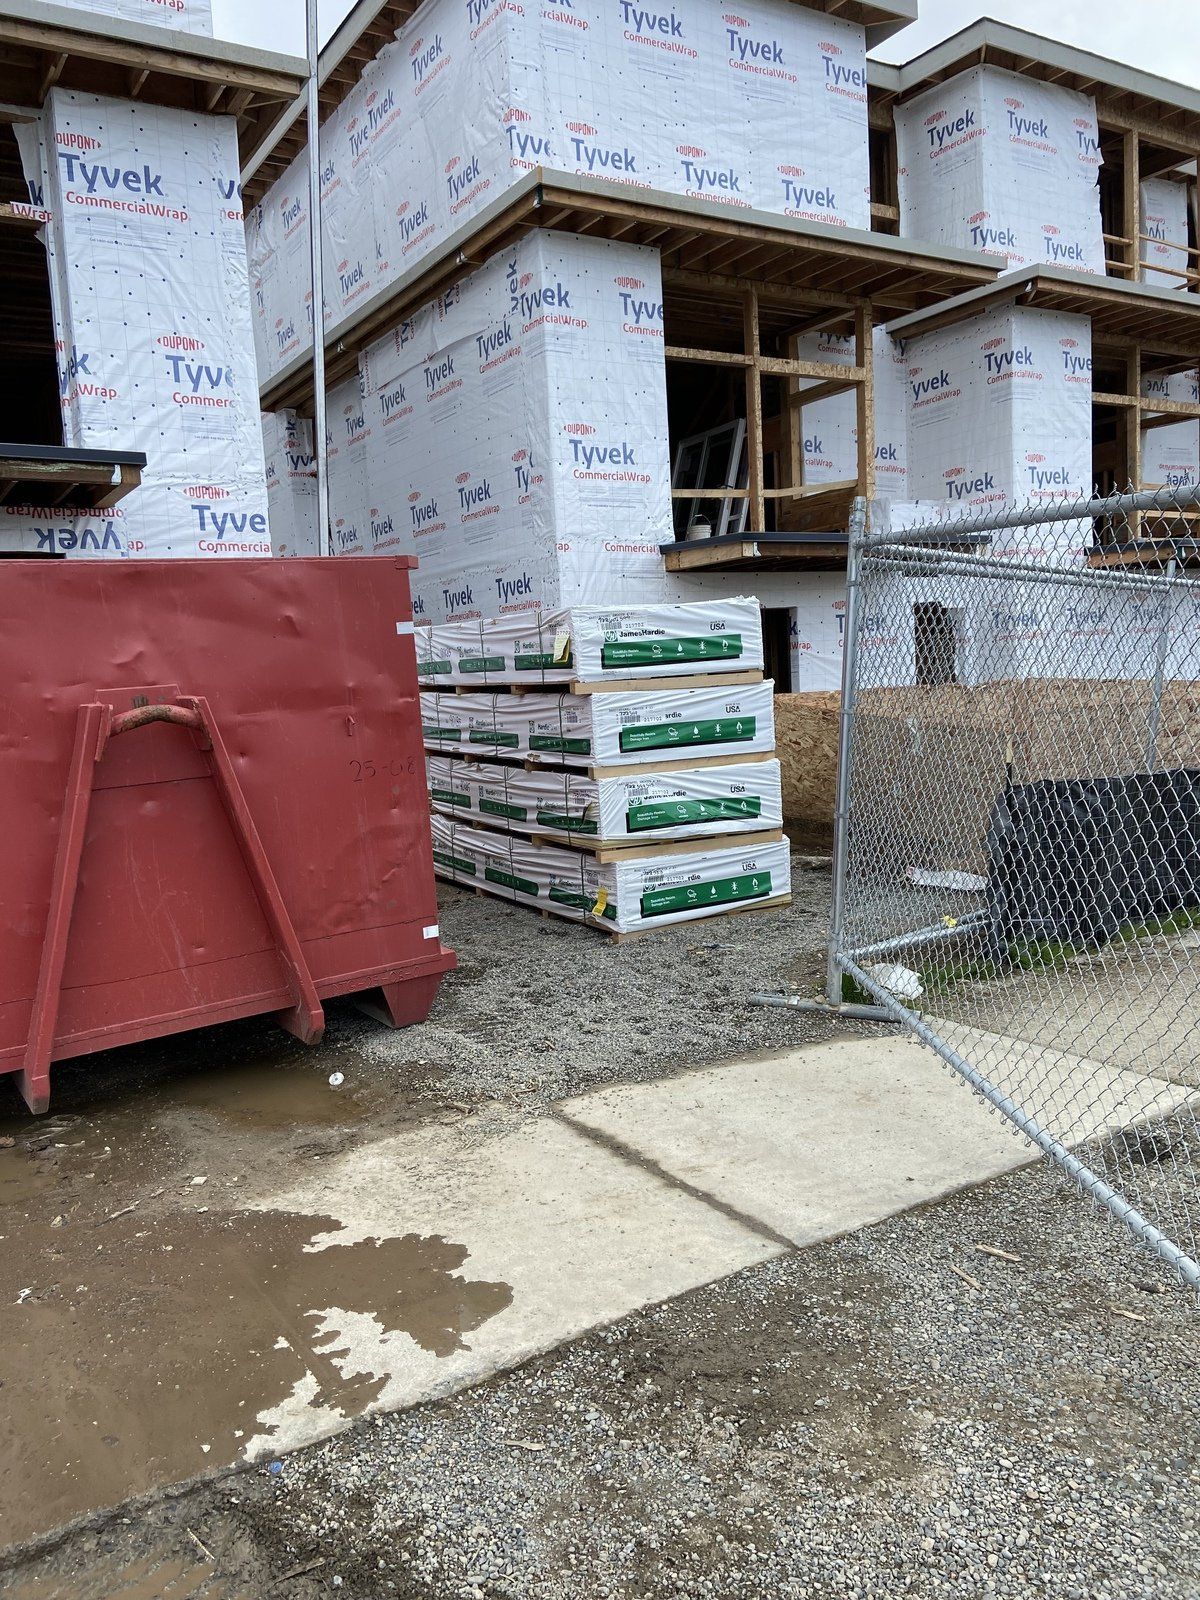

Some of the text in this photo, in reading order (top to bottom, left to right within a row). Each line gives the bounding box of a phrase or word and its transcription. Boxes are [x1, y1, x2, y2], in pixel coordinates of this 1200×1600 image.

[467, 0, 496, 25] Tyv
[620, 0, 683, 38] Tyvek
[411, 34, 443, 82] Tyvek
[623, 29, 698, 59] CommercialWrap
[726, 28, 784, 65] Tyvek
[728, 57, 798, 84] CommercialWrap
[825, 82, 868, 103] Commercial
[368, 88, 394, 130] Tyvek
[927, 109, 975, 147] Tyvek
[1007, 109, 1049, 139] Tyvek
[56, 132, 97, 151] DUPONT
[570, 136, 637, 173] Tyvek
[929, 127, 987, 160] CommercialWrap
[1008, 133, 1058, 155] CommercialWrap
[58, 152, 164, 197] Tyvek
[446, 155, 480, 200] Tyvek
[680, 160, 741, 192] Tyvek
[66, 190, 189, 222] CommercialWrap
[781, 178, 836, 210] Tyvek
[282, 196, 301, 230] Tyvek
[398, 200, 429, 242] Tyvek
[784, 207, 847, 228] CommercialWrap
[970, 225, 1015, 248] Tyvek
[1044, 236, 1083, 261] Tyvek
[339, 261, 364, 295] Tyvek
[520, 282, 571, 320] Tyvek
[276, 320, 295, 349] Tyvek
[521, 314, 588, 335] CommercialWrap
[162, 335, 200, 351] DUPONT
[475, 321, 512, 362] Tyvek
[423, 354, 455, 391] Tyvek
[479, 345, 522, 375] CommercialWrap
[984, 346, 1033, 374] Tyvek
[986, 370, 1043, 385] CommercialWrap
[379, 383, 406, 417] Tyvek
[567, 423, 594, 436] DUPONT
[569, 439, 636, 469] Tyvek
[573, 468, 651, 484] CommercialWrap
[946, 472, 995, 500] Tyvek
[1028, 466, 1070, 489] Tyvek
[188, 486, 226, 500] DUPONT
[458, 479, 491, 512] Tyvek
[410, 498, 439, 525] Tyvek
[460, 504, 501, 524] CommercialWrap
[336, 525, 358, 549] Tyvek
[370, 514, 394, 542] Tyvek
[604, 542, 660, 556] Commercial
[443, 585, 474, 612] Tyvek
[495, 572, 533, 603] Tyvek
[498, 600, 542, 614] CommercialWrap
[619, 628, 666, 638] JamesHardie
[709, 622, 726, 631] USA
[725, 705, 741, 714] USA
[730, 785, 746, 793] USA
[742, 862, 757, 871] USA
